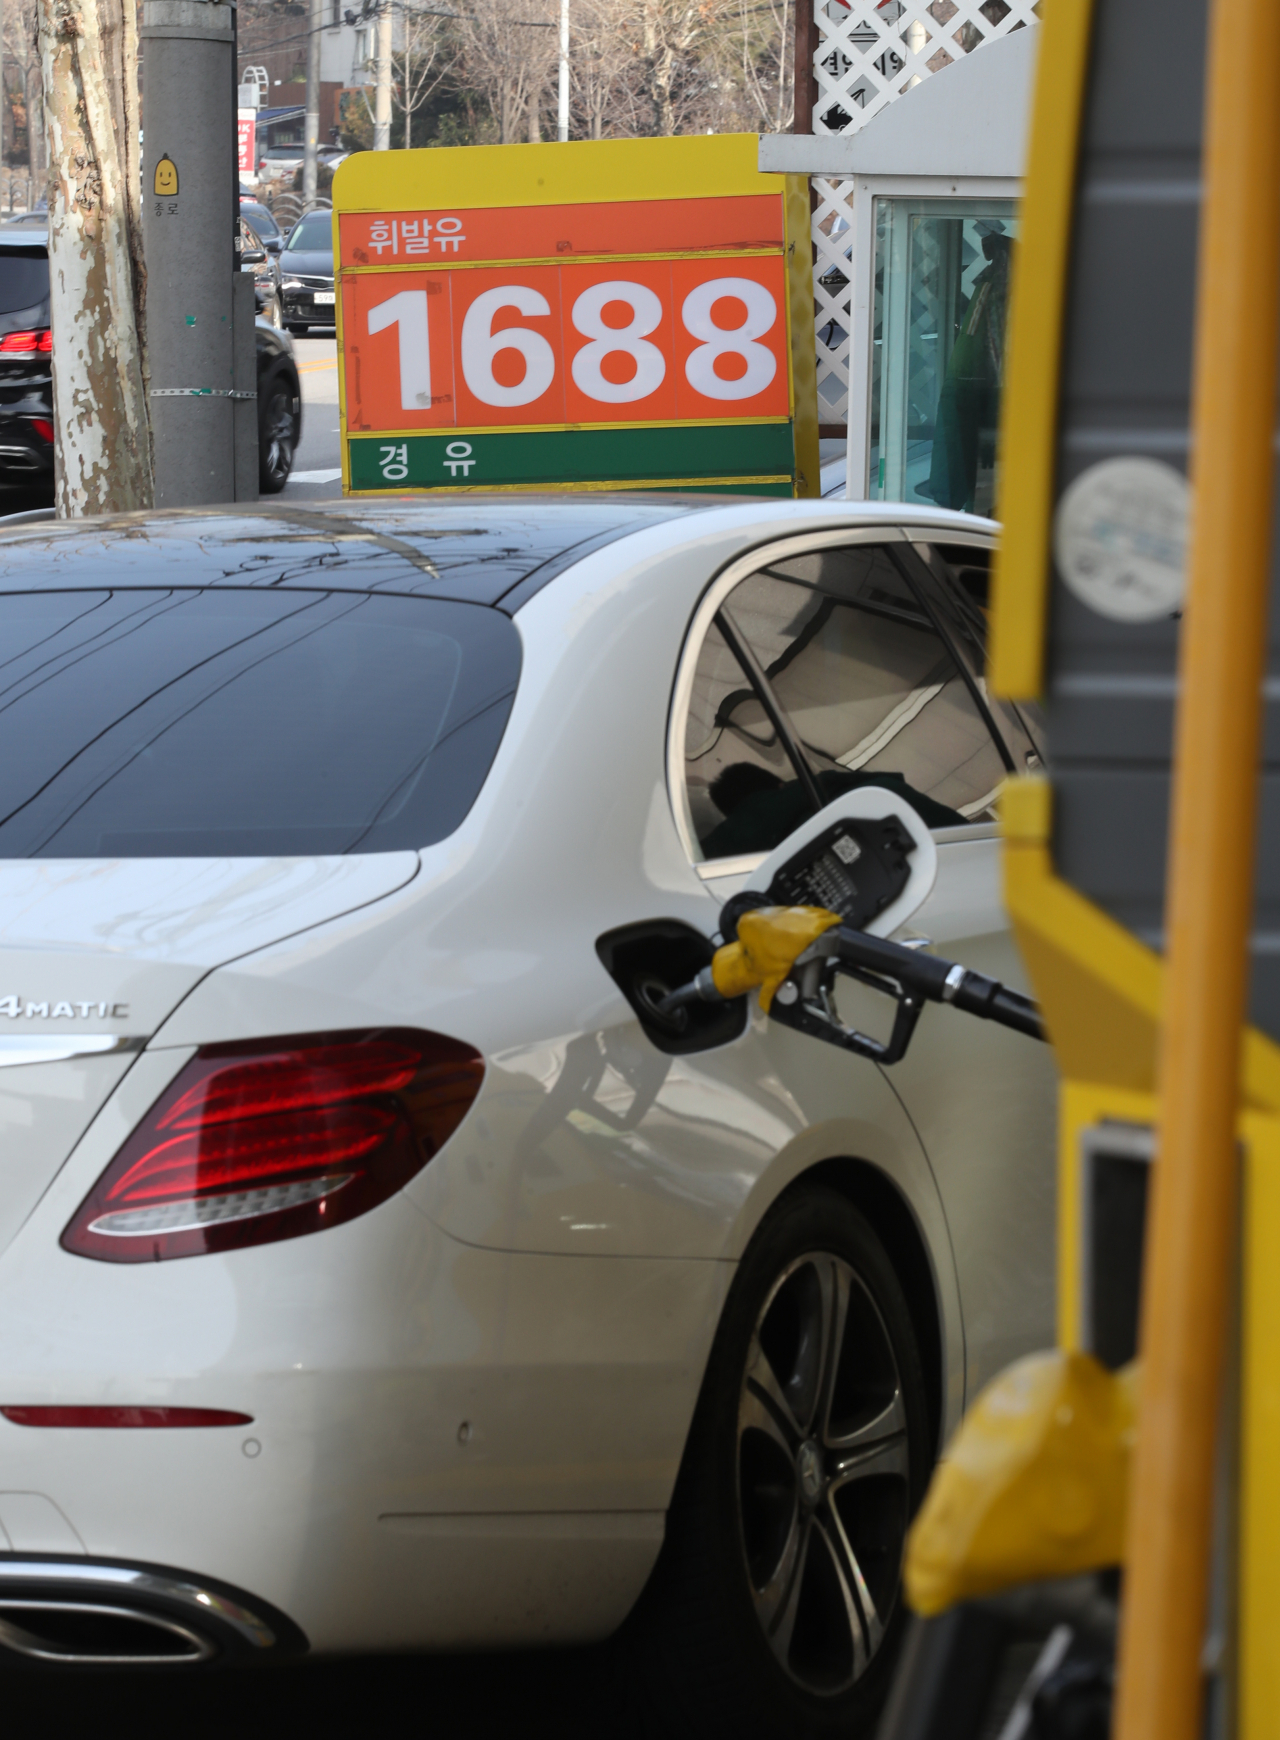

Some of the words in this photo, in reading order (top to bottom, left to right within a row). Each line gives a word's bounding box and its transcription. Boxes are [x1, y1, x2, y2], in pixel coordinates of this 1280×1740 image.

[154, 202, 179, 217] 종로
[368, 217, 466, 255] 휘발유
[367, 277, 777, 410] 1688
[0, 995, 130, 1019] 4MATIC
